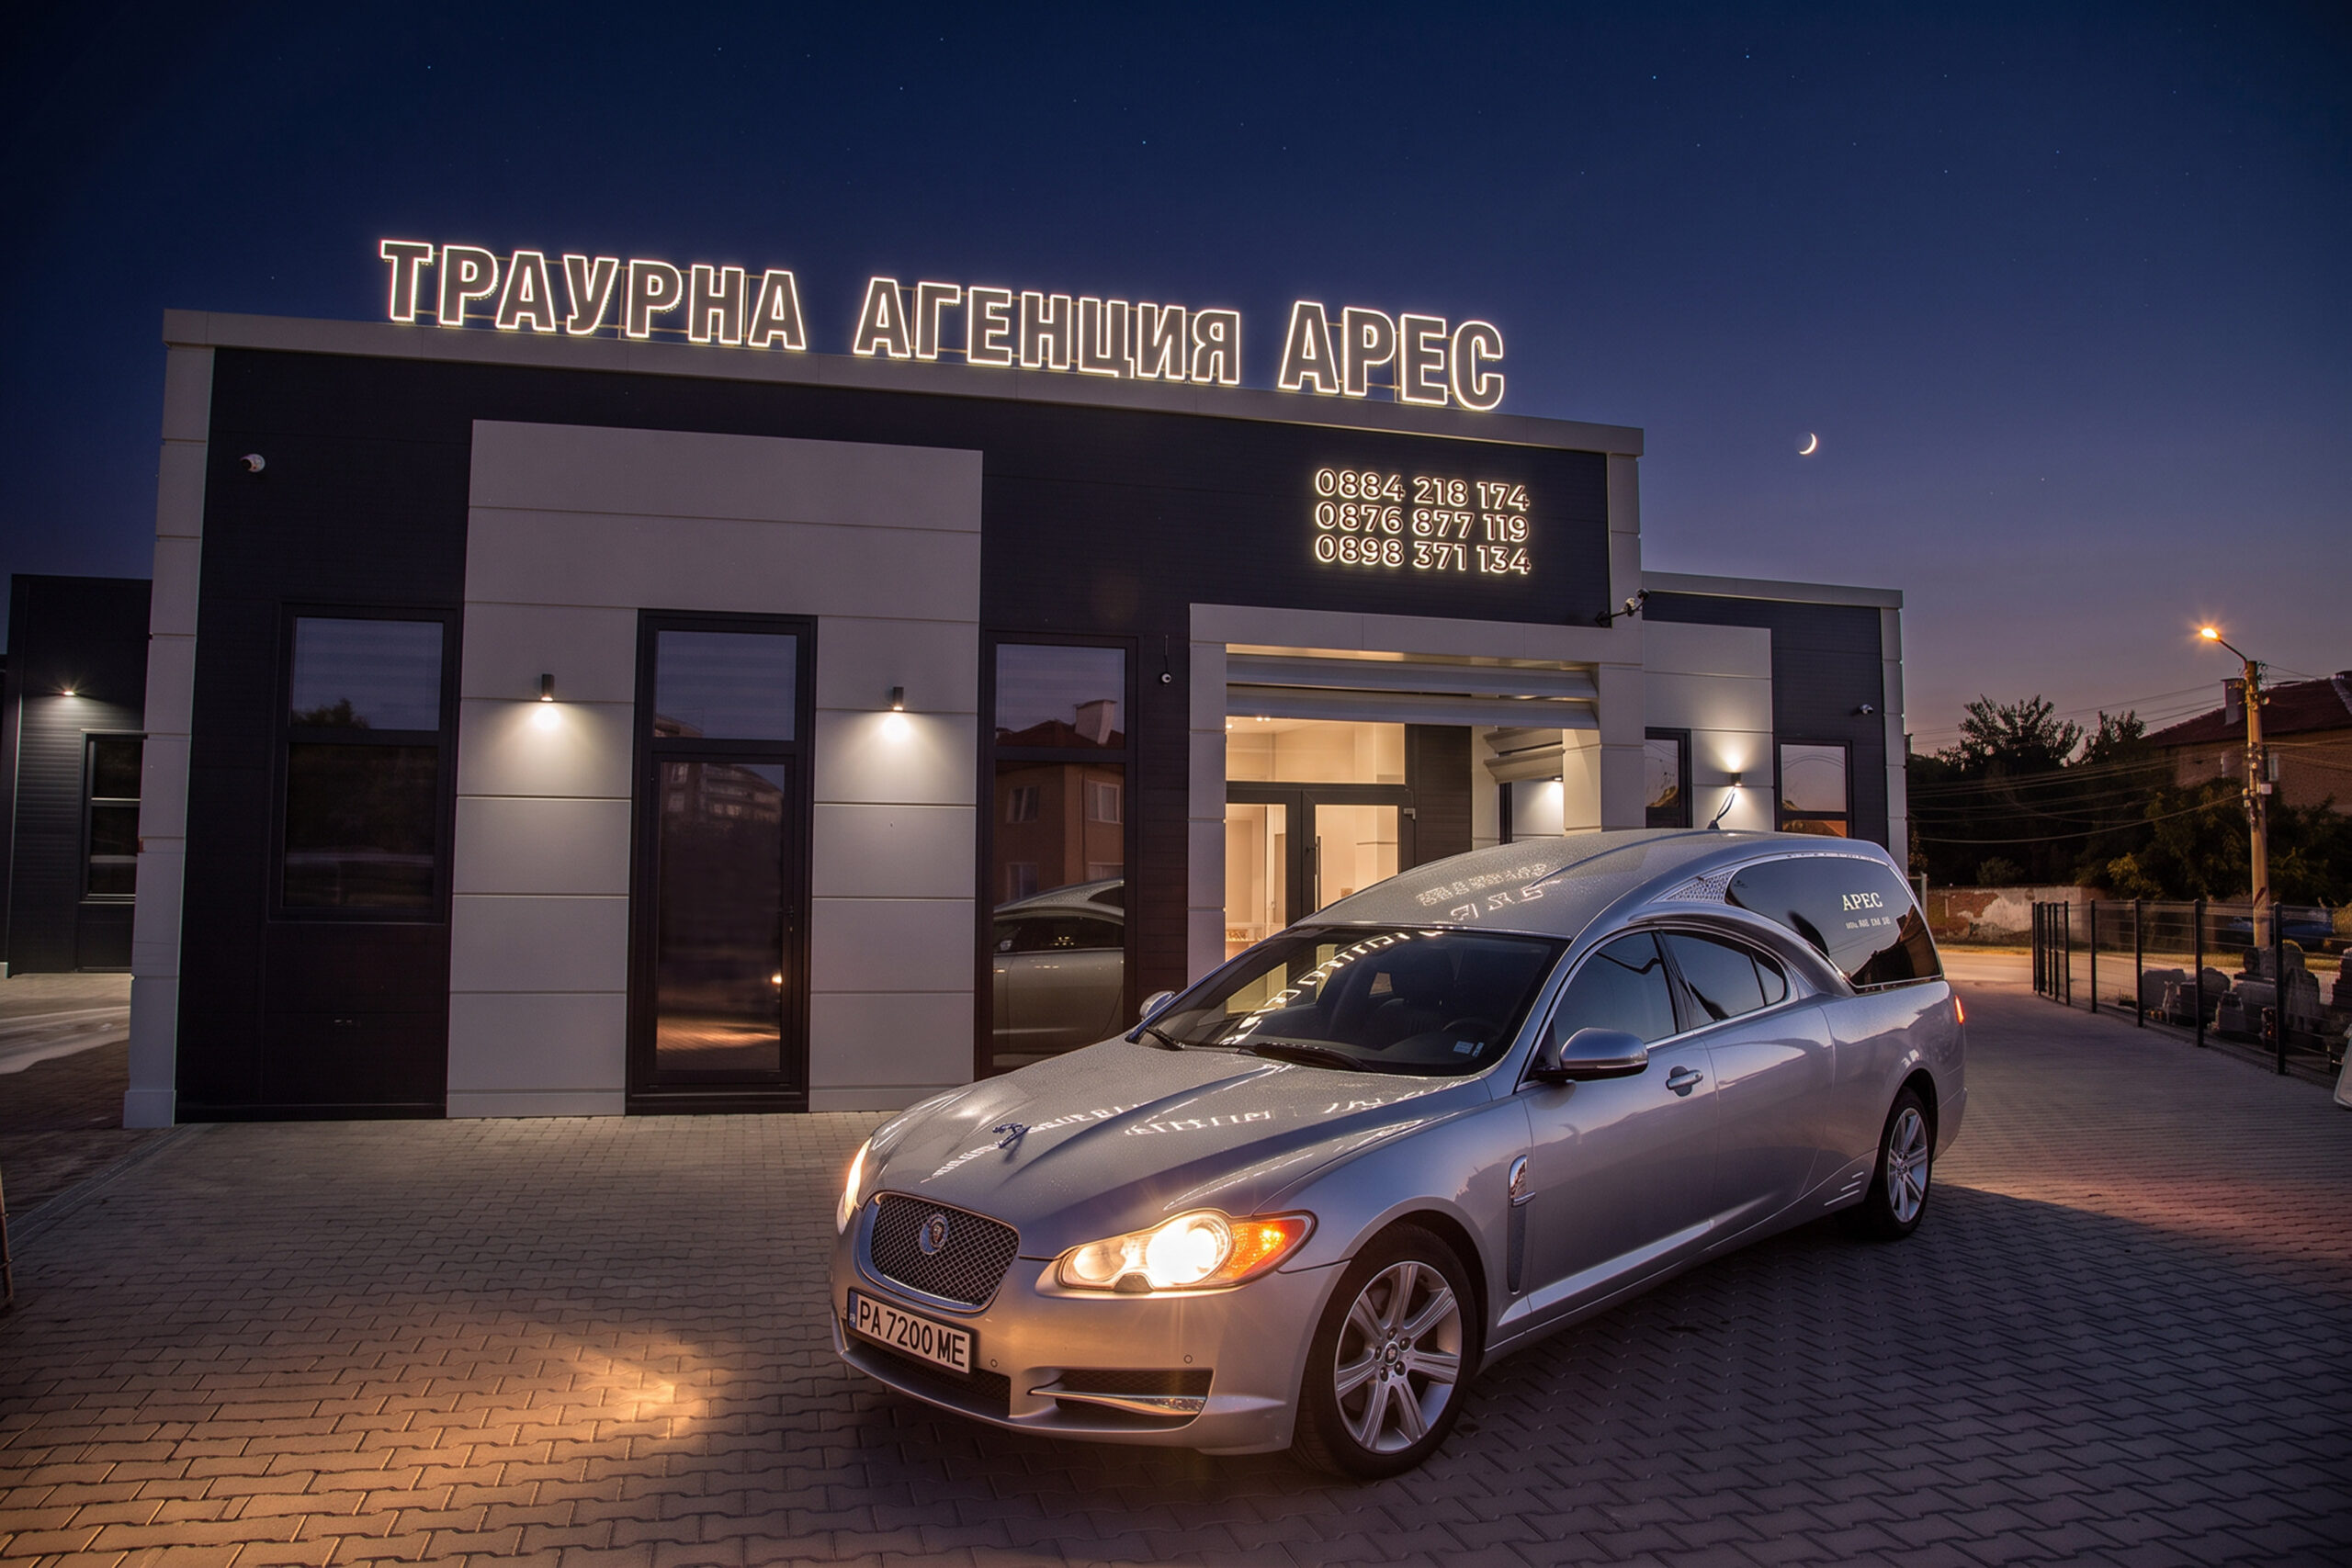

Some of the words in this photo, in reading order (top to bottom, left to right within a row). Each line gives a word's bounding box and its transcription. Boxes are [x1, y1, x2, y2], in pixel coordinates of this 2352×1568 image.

[379, 239, 807, 351] ТРАУРНА
[853, 276, 1240, 386] АГЕНЦИЯ
[1278, 301, 1505, 412] АРЕС
[1315, 468, 1405, 502] 0884
[1413, 476, 1469, 507] 218
[1477, 480, 1531, 512] 174
[1315, 502, 1404, 535] 0876
[1412, 508, 1474, 539] 877
[1483, 513, 1530, 543] 119
[1315, 534, 1405, 568] 0898
[1413, 541, 1467, 571] 371
[1477, 545, 1532, 575] 134
[1842, 892, 1883, 911] АРЕС
[886, 1310, 933, 1355] 7200
